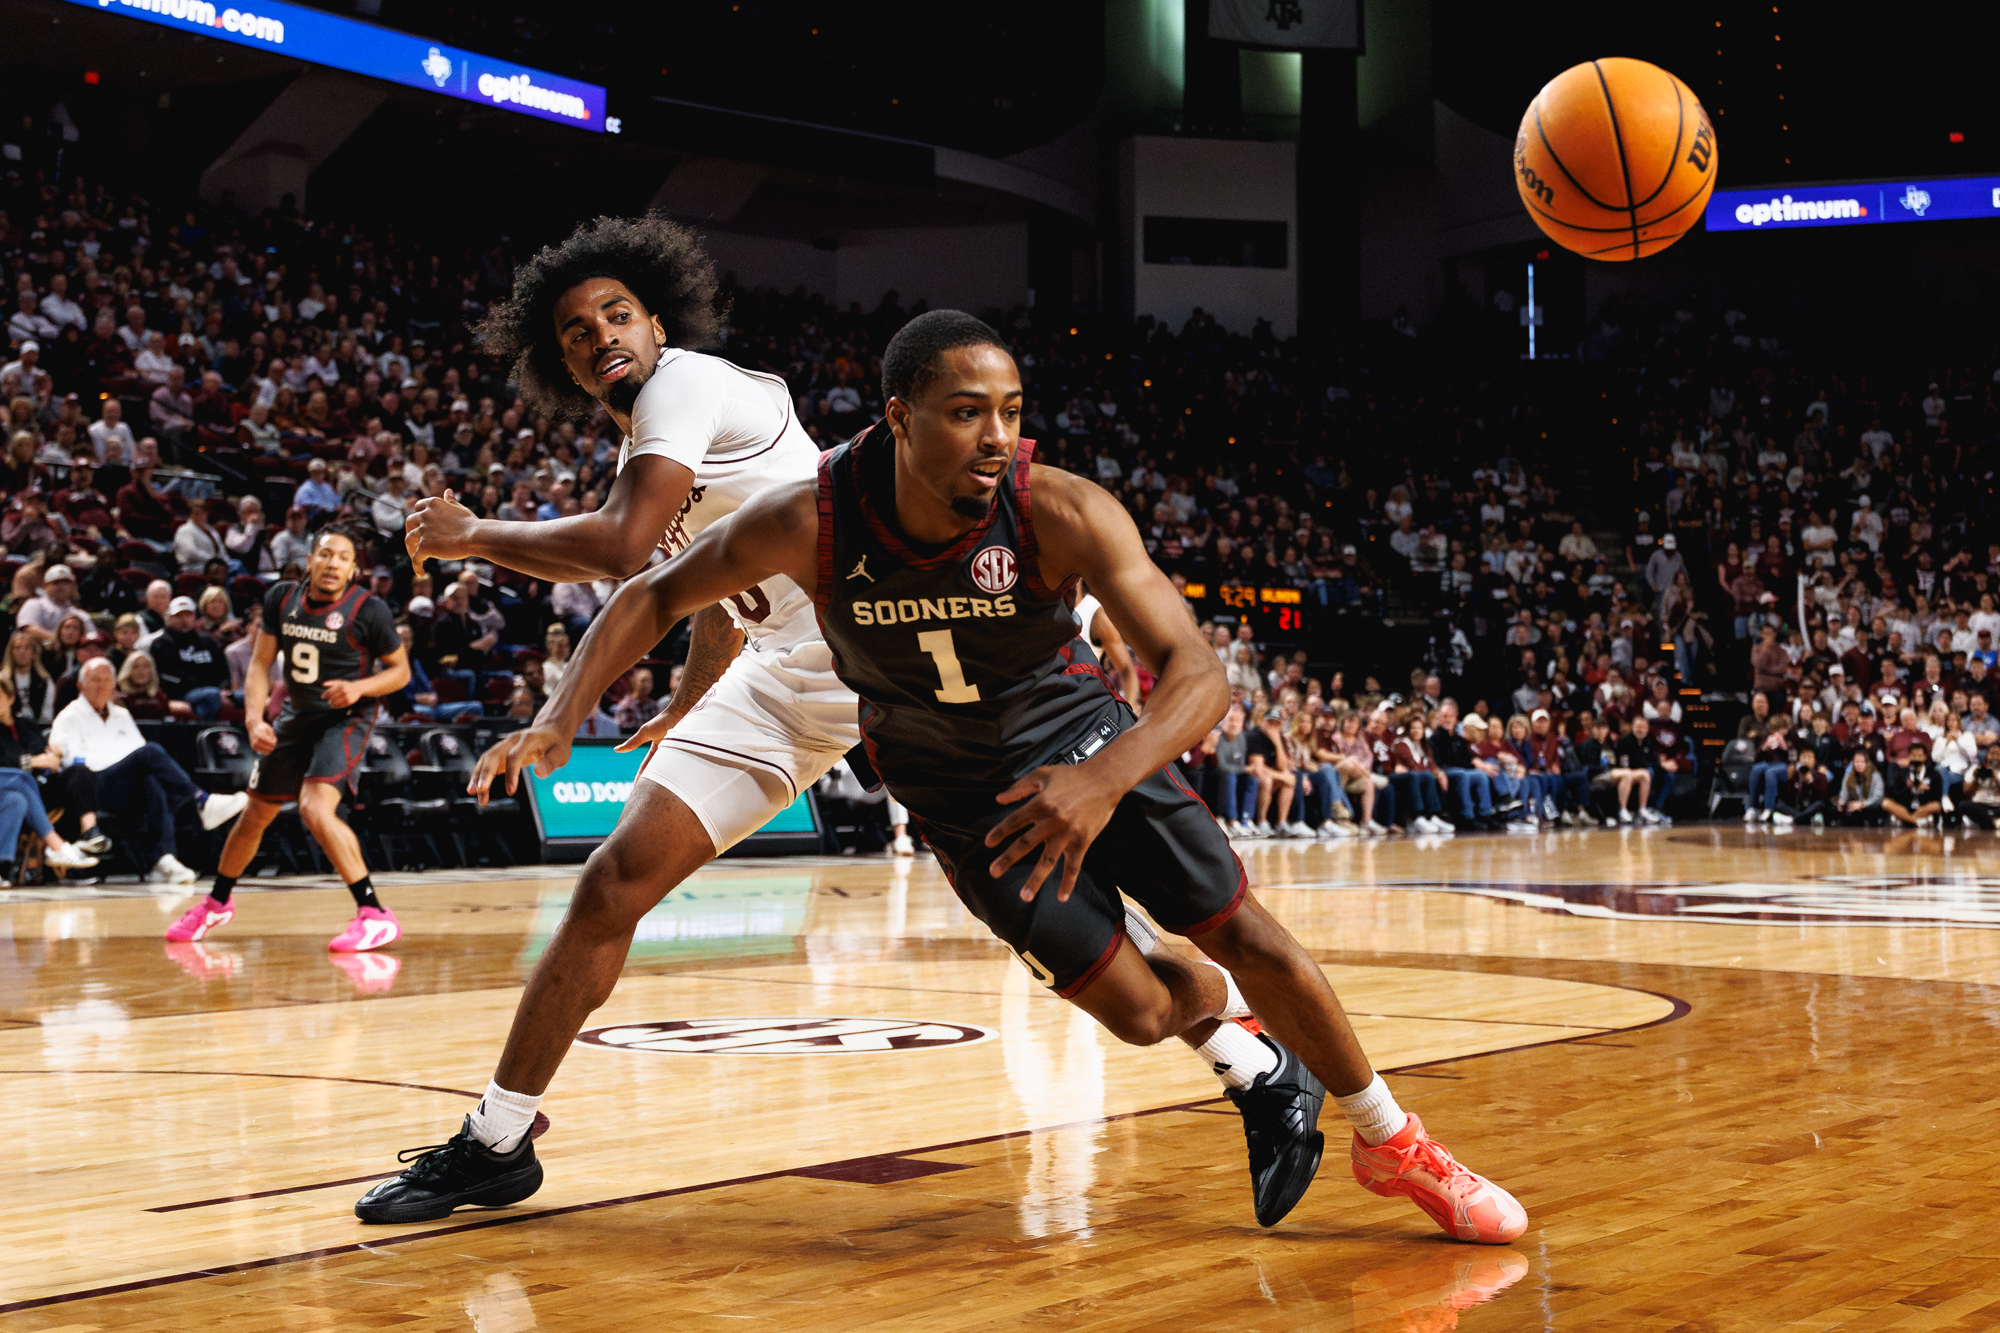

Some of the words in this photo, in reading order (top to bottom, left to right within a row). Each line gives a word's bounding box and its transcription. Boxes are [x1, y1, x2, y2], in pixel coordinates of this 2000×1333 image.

[1735, 194, 1868, 226] optimum.
[976, 550, 1015, 590] SEC
[852, 595, 1017, 626] SOONERS
[282, 622, 338, 644] SOONERS
[290, 641, 320, 684] 9
[917, 628, 981, 704] 1
[553, 781, 592, 803] OLD
